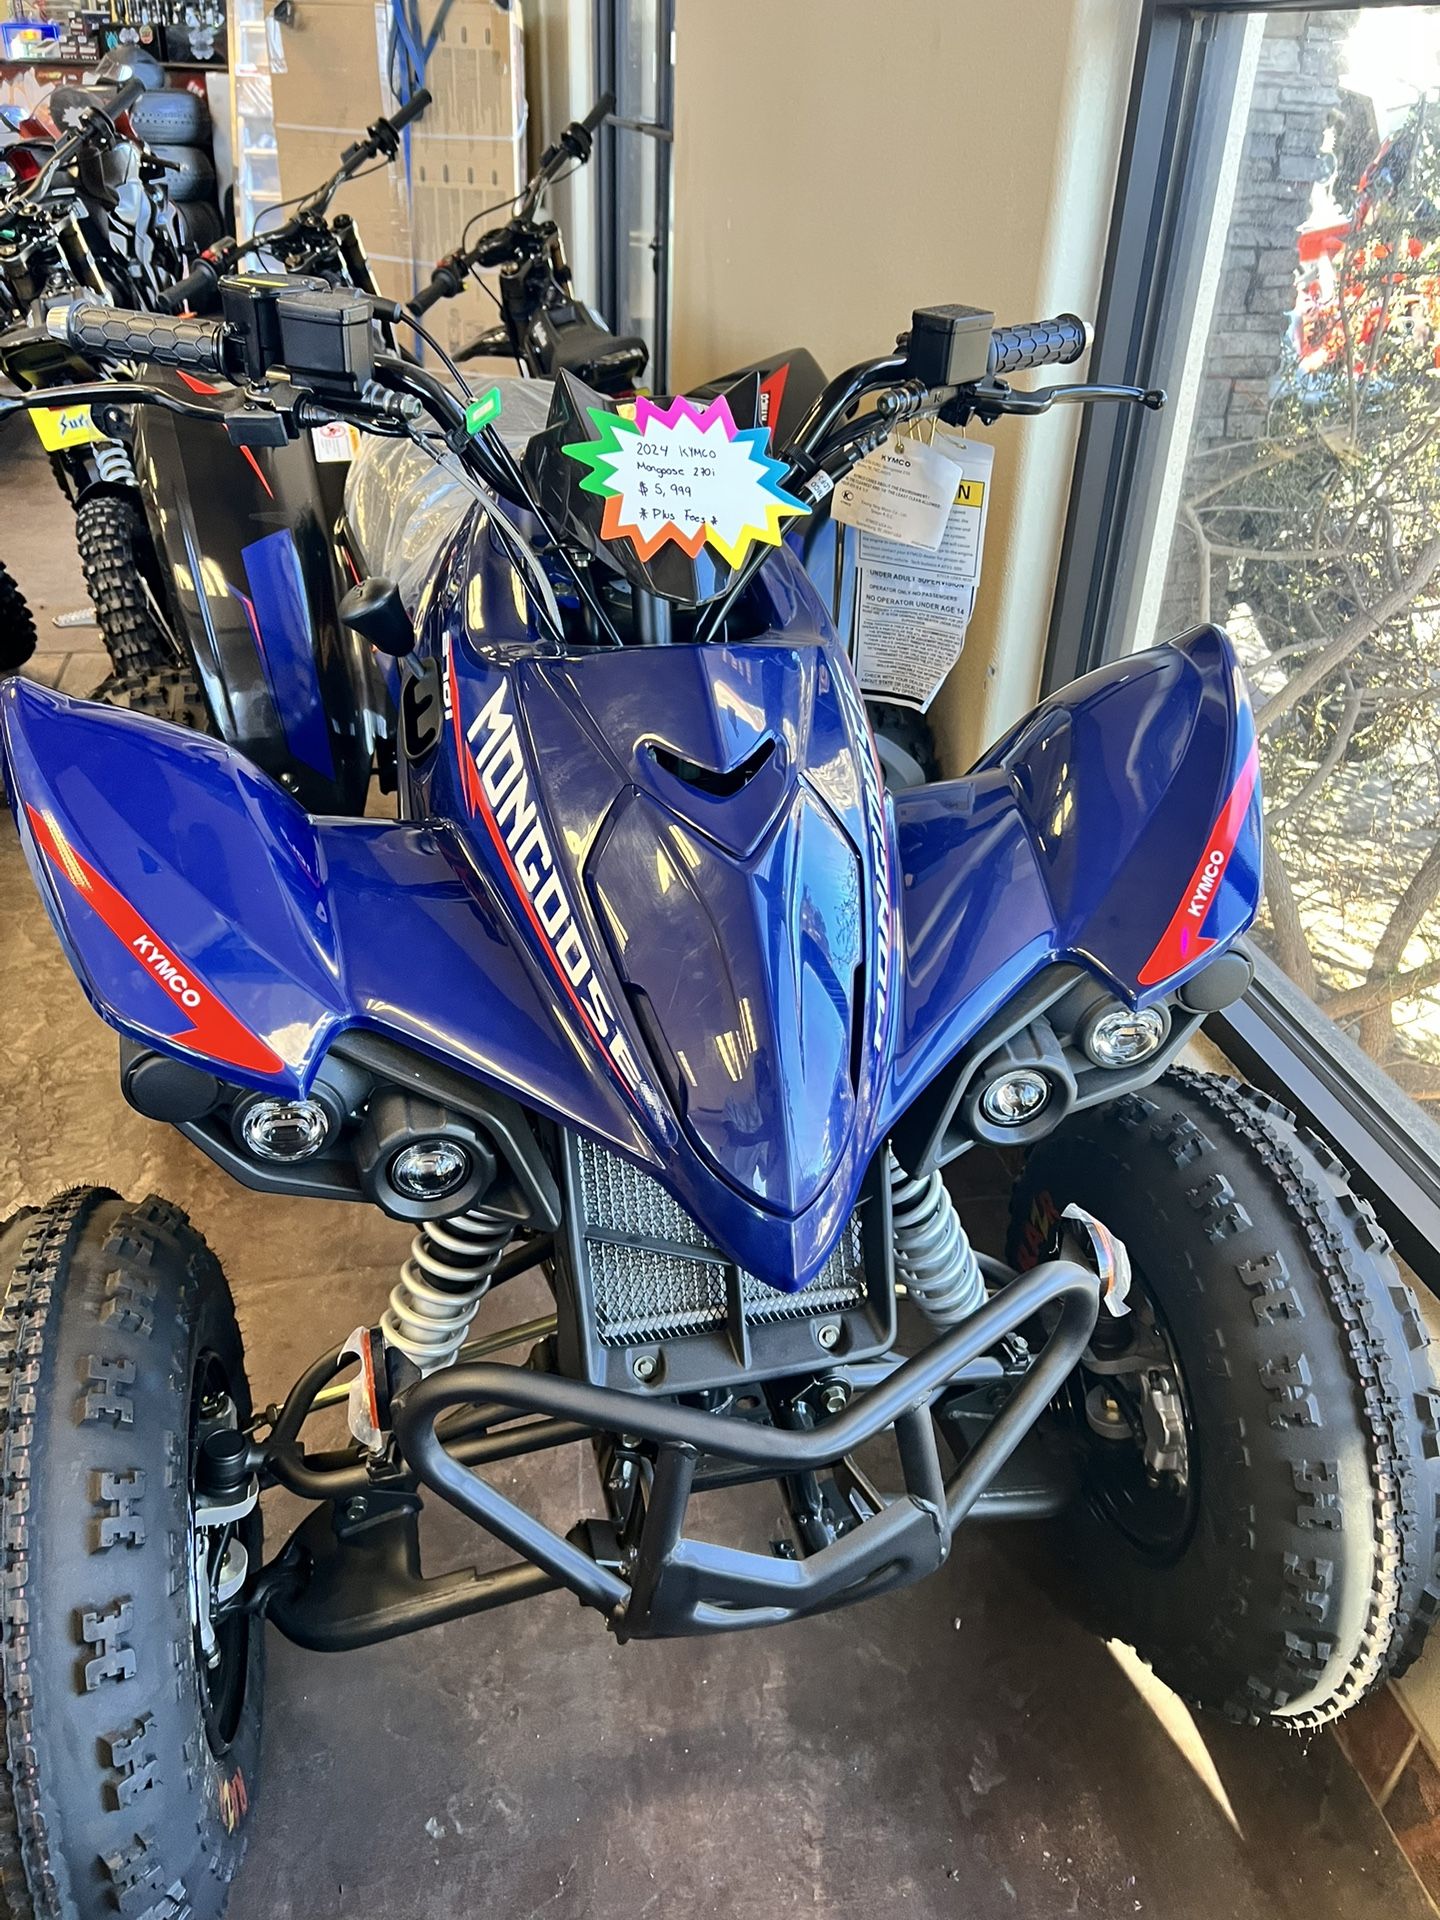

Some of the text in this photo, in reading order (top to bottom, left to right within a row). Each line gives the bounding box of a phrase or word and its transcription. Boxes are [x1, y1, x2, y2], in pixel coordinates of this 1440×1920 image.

[636, 441, 716, 459] 2024 KYMCO
[636, 461, 715, 478] Mongoose 270i
[881, 454, 911, 468] KYMCO
[652, 508, 675, 520] Plus
[869, 569, 892, 579] UNDER
[893, 573, 916, 582] ADULT
[866, 594, 876, 602] NO
[876, 597, 914, 607] OPERATOR
[916, 601, 939, 610] UNDER
[940, 605, 955, 613] AGE
[467, 677, 642, 1091] MONGOOSE
[1187, 850, 1225, 917] KYMCO
[132, 934, 201, 1007] KYMCO
